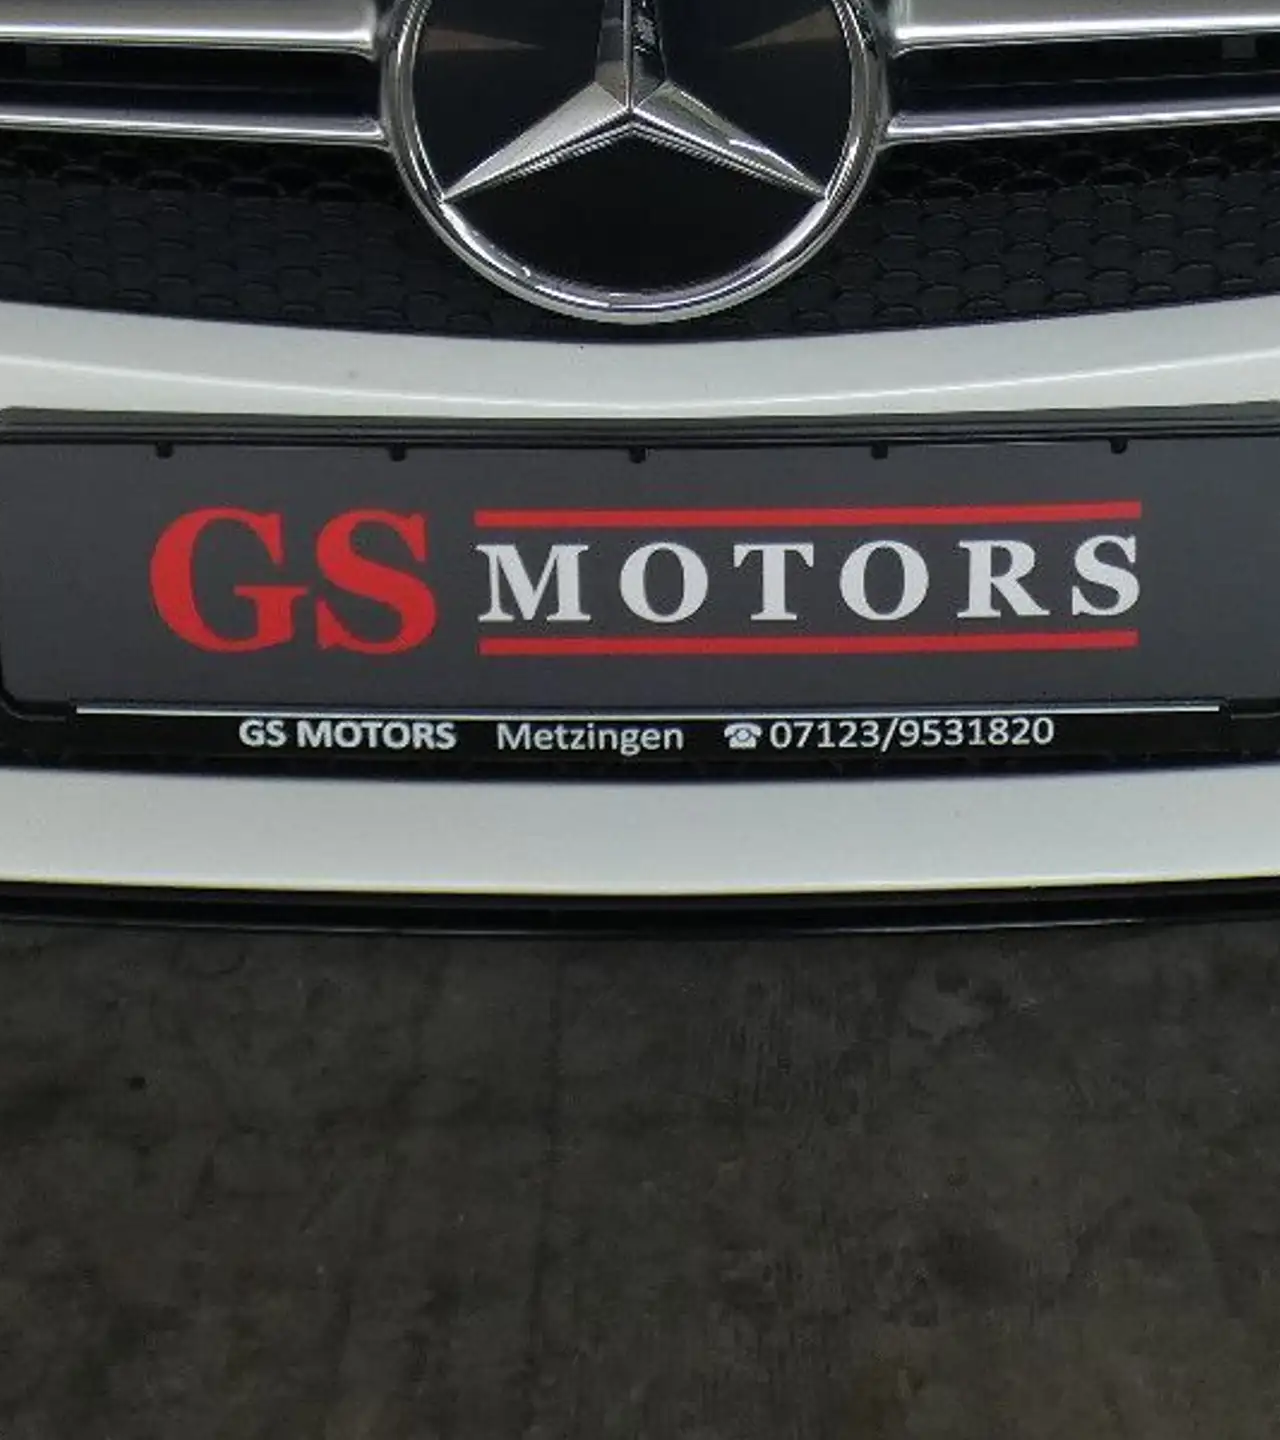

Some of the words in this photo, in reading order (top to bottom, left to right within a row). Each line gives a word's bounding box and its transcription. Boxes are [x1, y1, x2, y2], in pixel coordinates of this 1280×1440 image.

[151, 507, 438, 653] GS
[476, 535, 1140, 623] MOTORS
[238, 718, 289, 748] GS
[296, 720, 457, 750] MOTORS
[496, 722, 684, 757] Metzingen
[769, 716, 1055, 753] 07123/9531820
